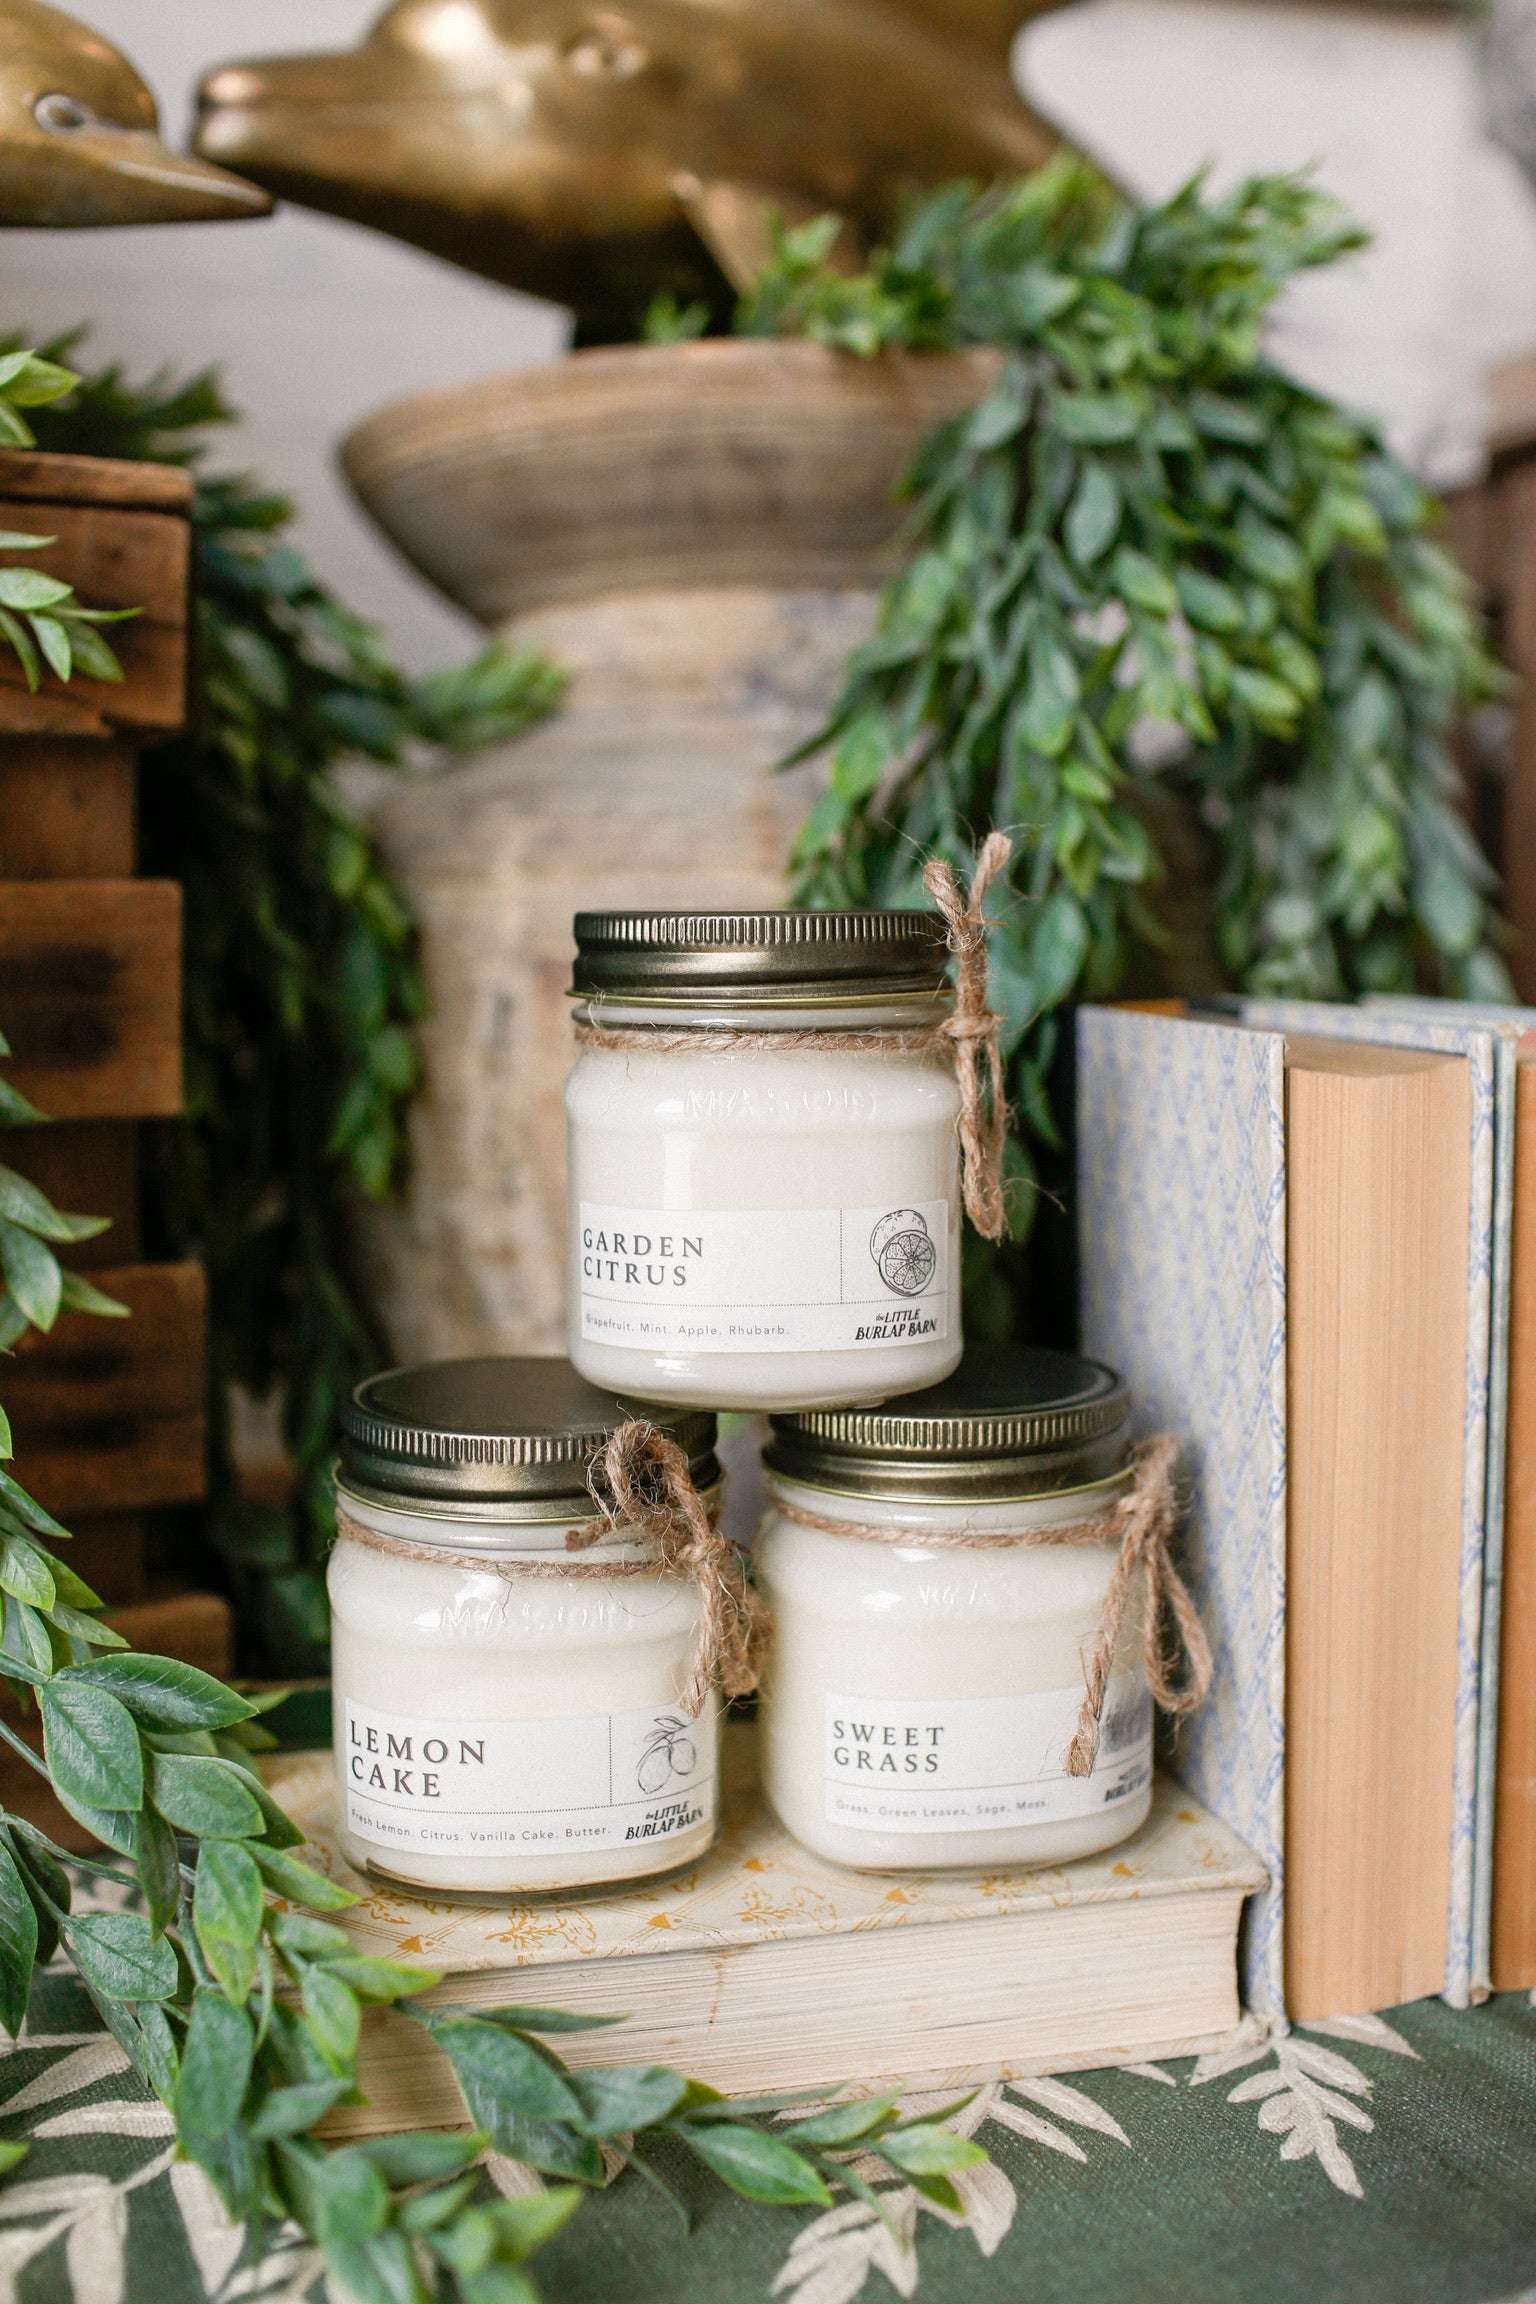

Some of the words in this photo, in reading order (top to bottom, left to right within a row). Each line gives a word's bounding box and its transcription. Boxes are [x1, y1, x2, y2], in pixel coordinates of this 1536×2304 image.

[583, 1228, 704, 1258] GARDEN
[583, 1256, 688, 1286] CITRUS
[884, 1308, 921, 1323] LITTLE
[855, 1323, 906, 1341] BURLAP
[908, 1318, 938, 1337] BARN
[350, 1719, 486, 1765] LEMON
[833, 1720, 945, 1746] SWEET
[833, 1746, 940, 1773] GRASS
[351, 1755, 442, 1798] CAKE
[654, 1801, 689, 1821] LITTLE
[878, 1806, 917, 1818] Green
[351, 1808, 373, 1826] Fresh
[470, 1831, 516, 1841] Vanilla
[625, 1817, 675, 1841] BURLAP
